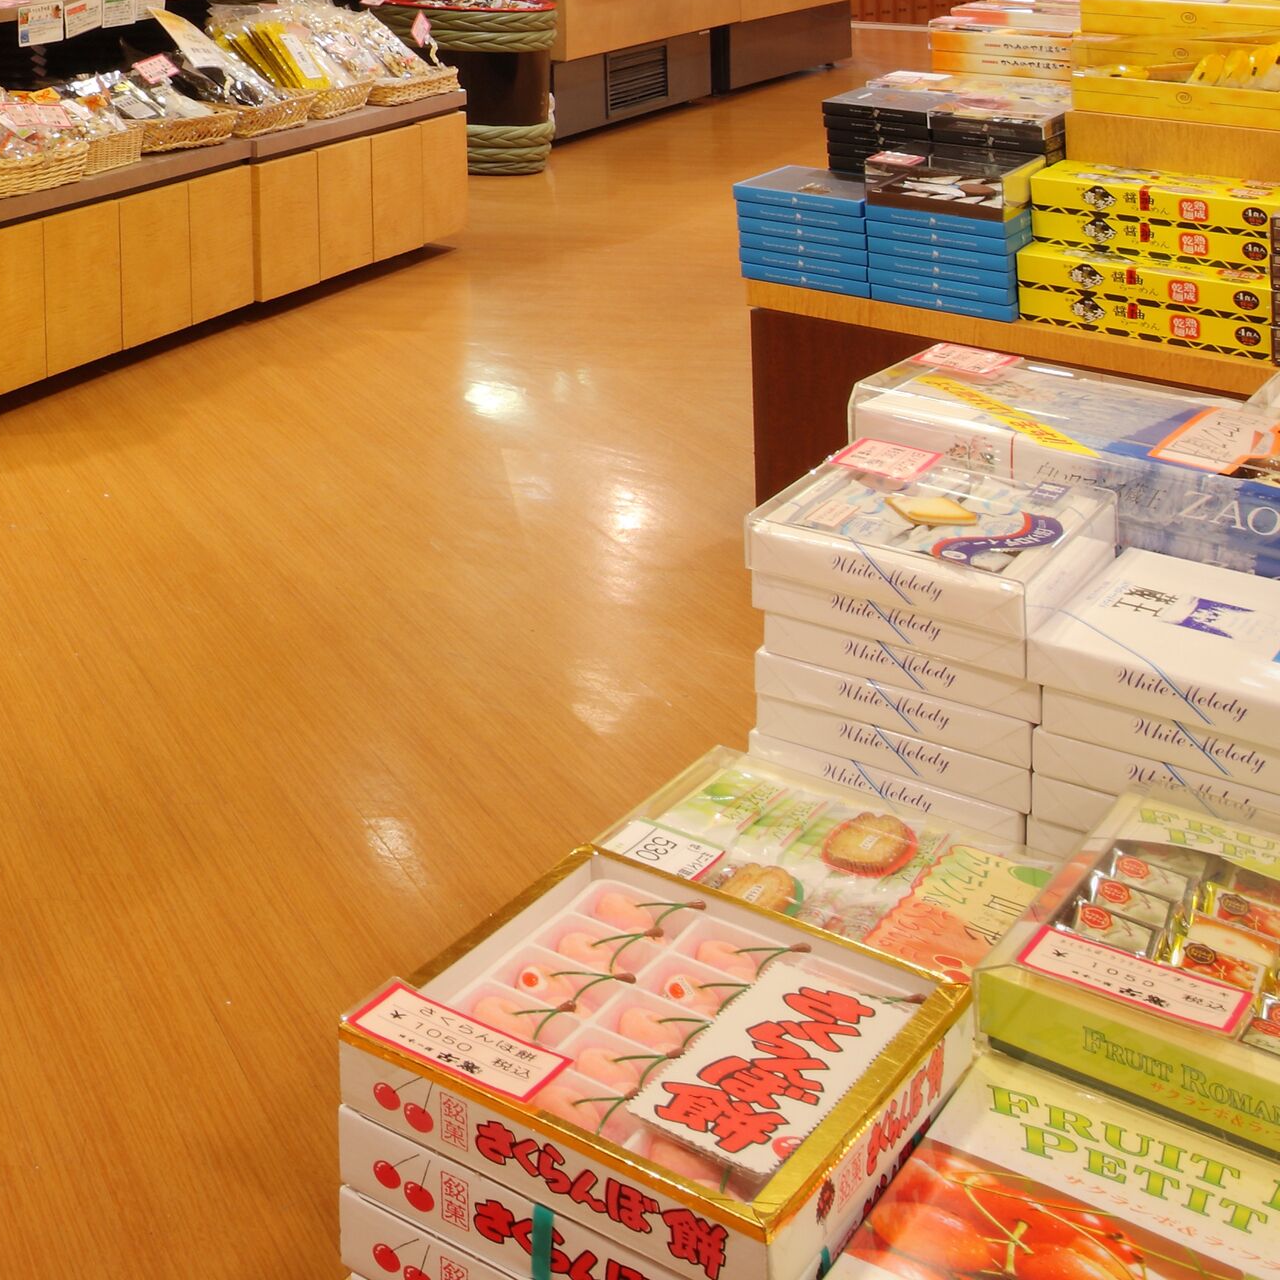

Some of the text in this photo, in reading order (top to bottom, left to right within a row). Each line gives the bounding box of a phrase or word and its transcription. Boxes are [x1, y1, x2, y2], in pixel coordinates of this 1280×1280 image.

[1084, 192, 1117, 211] 喜多方
[1084, 226, 1117, 244] 喜多方
[1070, 268, 1104, 289] 喜多方
[1072, 302, 1106, 322] 喜多方
[831, 554, 944, 601] White Melody
[830, 593, 943, 640] White Melody
[842, 639, 957, 689] White Melody
[838, 680, 951, 730] White Melody
[1116, 667, 1250, 722] White Melody
[838, 722, 951, 774] White Melody
[1132, 717, 1267, 774] White Melody
[821, 762, 933, 813] White Melody
[635, 836, 678, 862] 530
[1181, 992, 1229, 1014] 税込
[413, 1020, 473, 1054] 1050
[491, 1056, 532, 1081] 税込
[418, 1005, 538, 1063] さくらんぼ餅
[1081, 1025, 1174, 1084] FRUIT
[654, 985, 877, 1154] さくらんぼ餅
[986, 1083, 1241, 1190] FRUIT
[475, 1120, 730, 1280] さくらんぼ餅
[1020, 1121, 1269, 1235] PETIT
